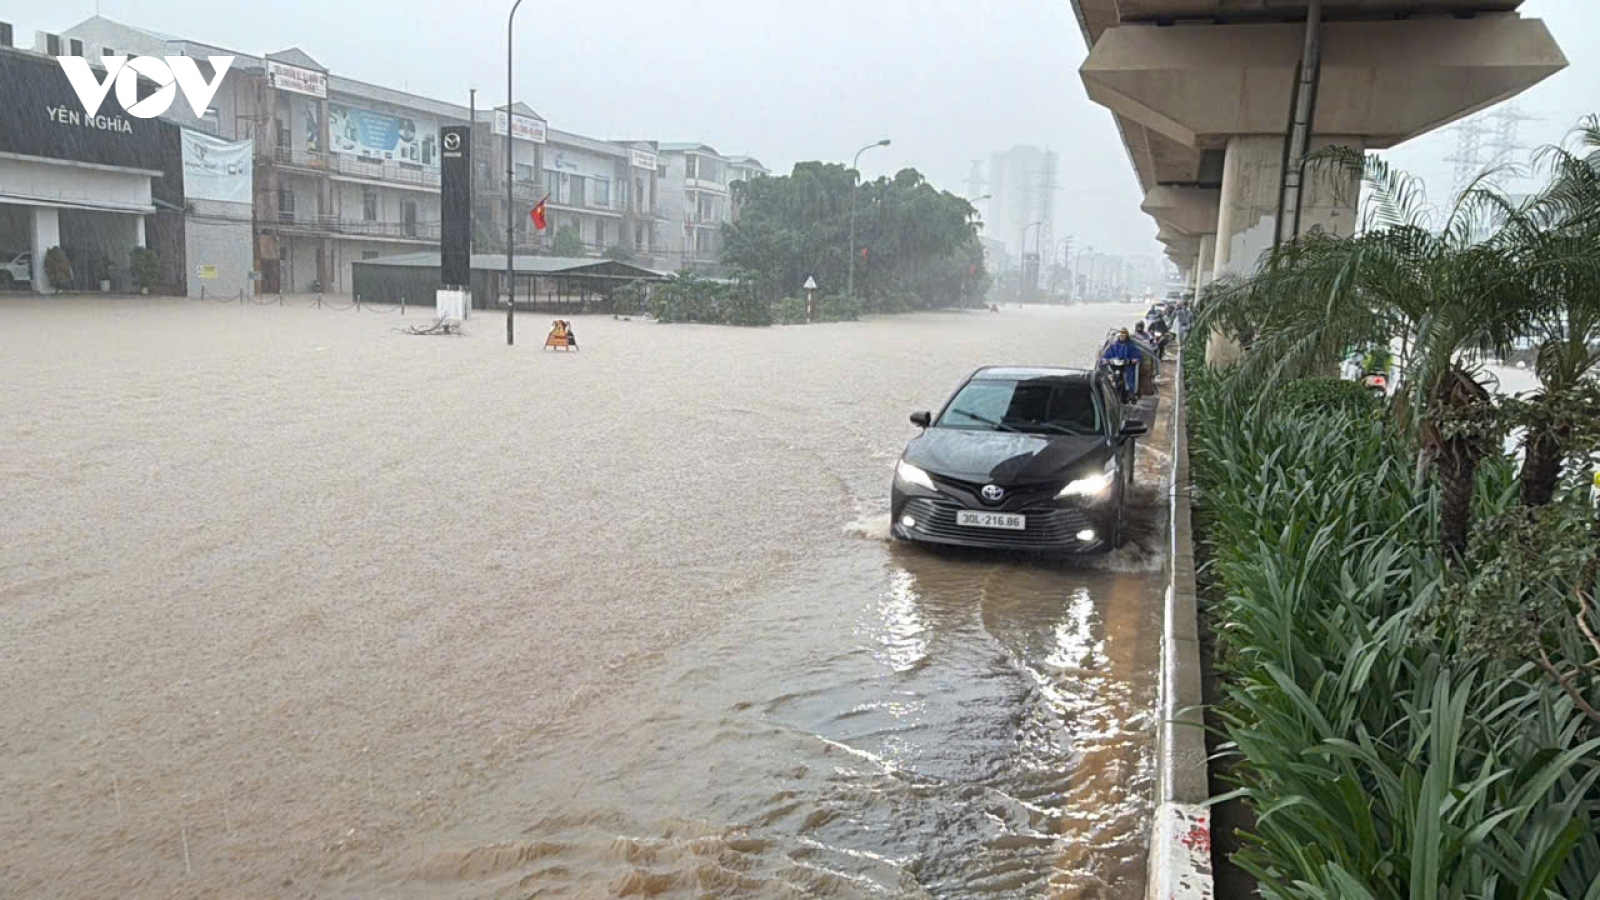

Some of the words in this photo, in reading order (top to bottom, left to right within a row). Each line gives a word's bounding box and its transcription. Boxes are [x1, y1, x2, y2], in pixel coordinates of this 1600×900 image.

[46, 104, 80, 126] YÊN
[84, 114, 133, 134] NGHĨA
[961, 513, 1020, 527] 30L-216.86
